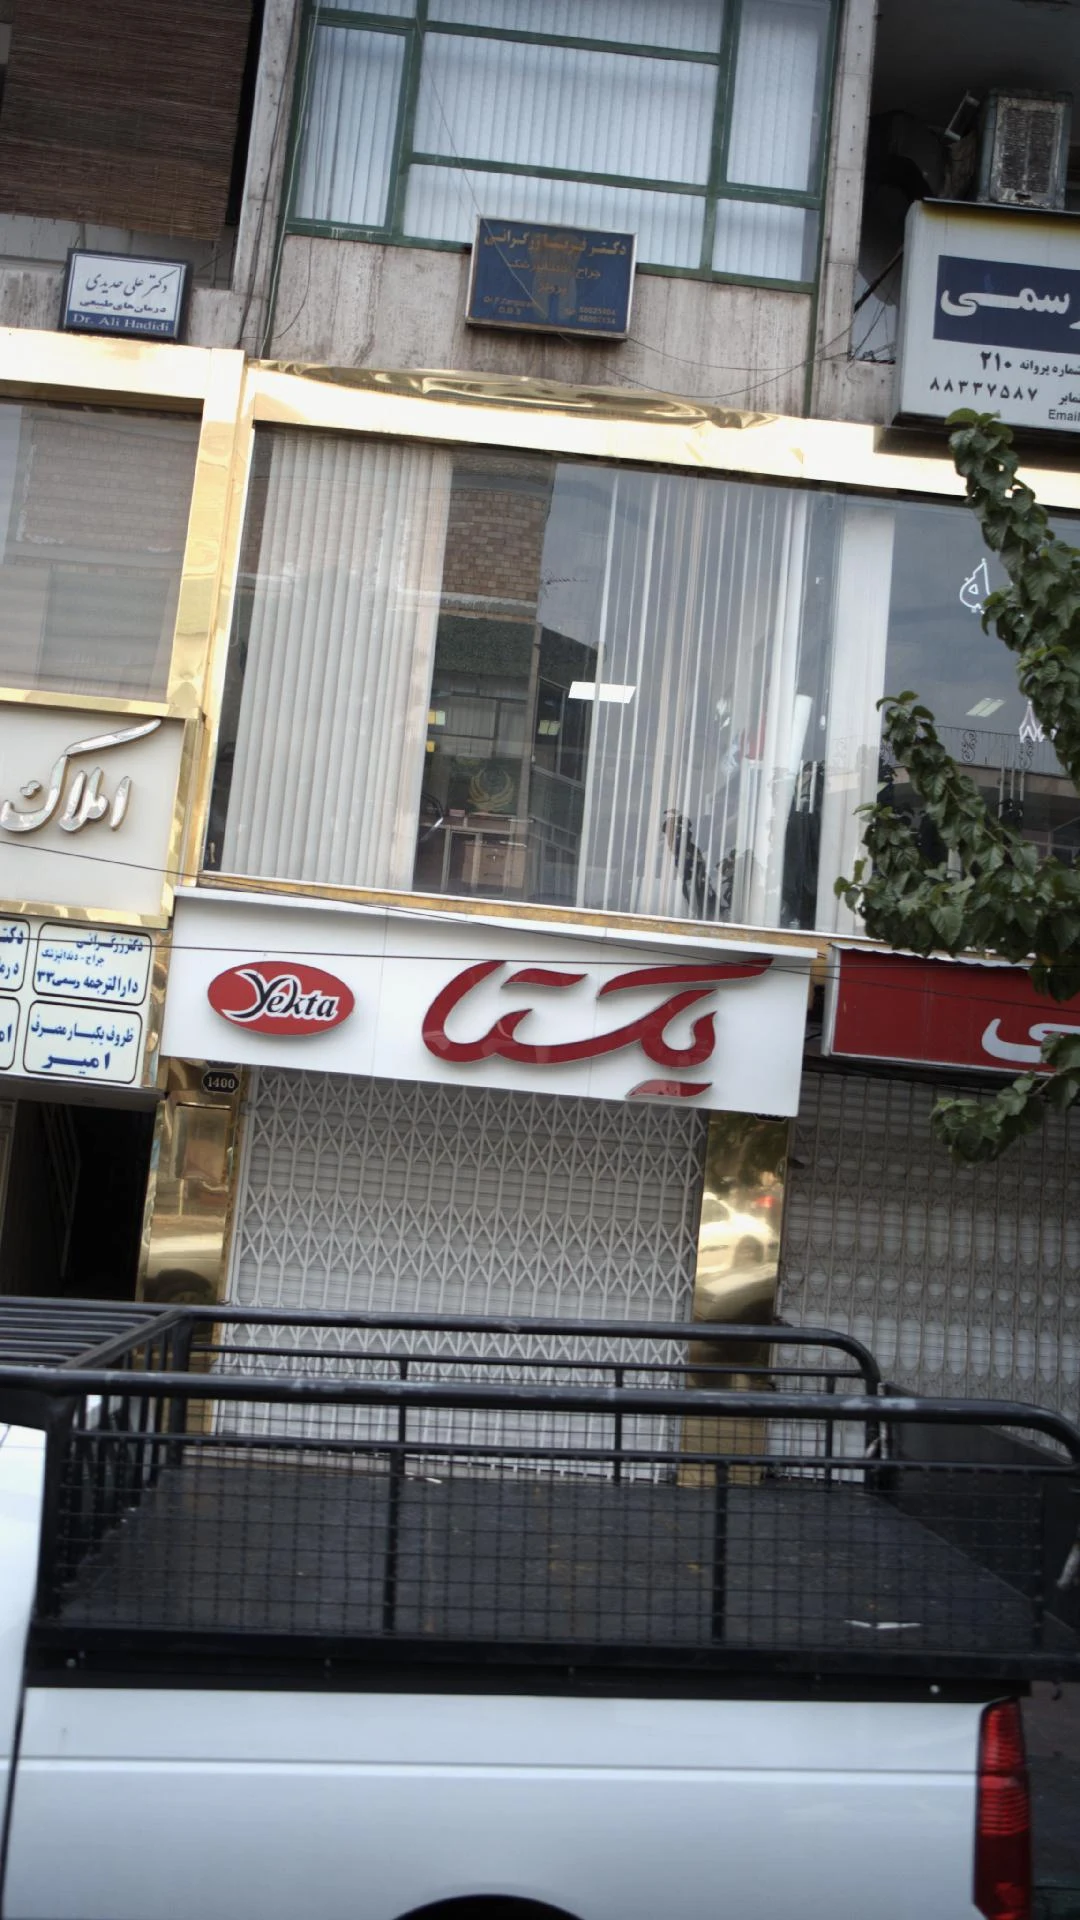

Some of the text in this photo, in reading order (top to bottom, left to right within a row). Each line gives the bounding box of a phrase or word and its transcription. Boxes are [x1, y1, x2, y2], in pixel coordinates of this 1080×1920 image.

[85, 269, 178, 298] دکتر علی حدیدی
[79, 297, 114, 308] طبیعی
[134, 304, 167, 314] درمان
[940, 287, 1080, 330] سمی
[72, 313, 170, 332] Dr. Ali Hadidi
[1019, 359, 1050, 376] پروانه
[1057, 391, 1080, 406] مابر
[52, 977, 80, 989] رسمی
[222, 969, 339, 1021] Yekta
[106, 1024, 135, 1047] ظروف
[421, 957, 774, 1099] یکتا
[41, 1051, 111, 1075] امیر
[207, 1076, 236, 1089] 1400
